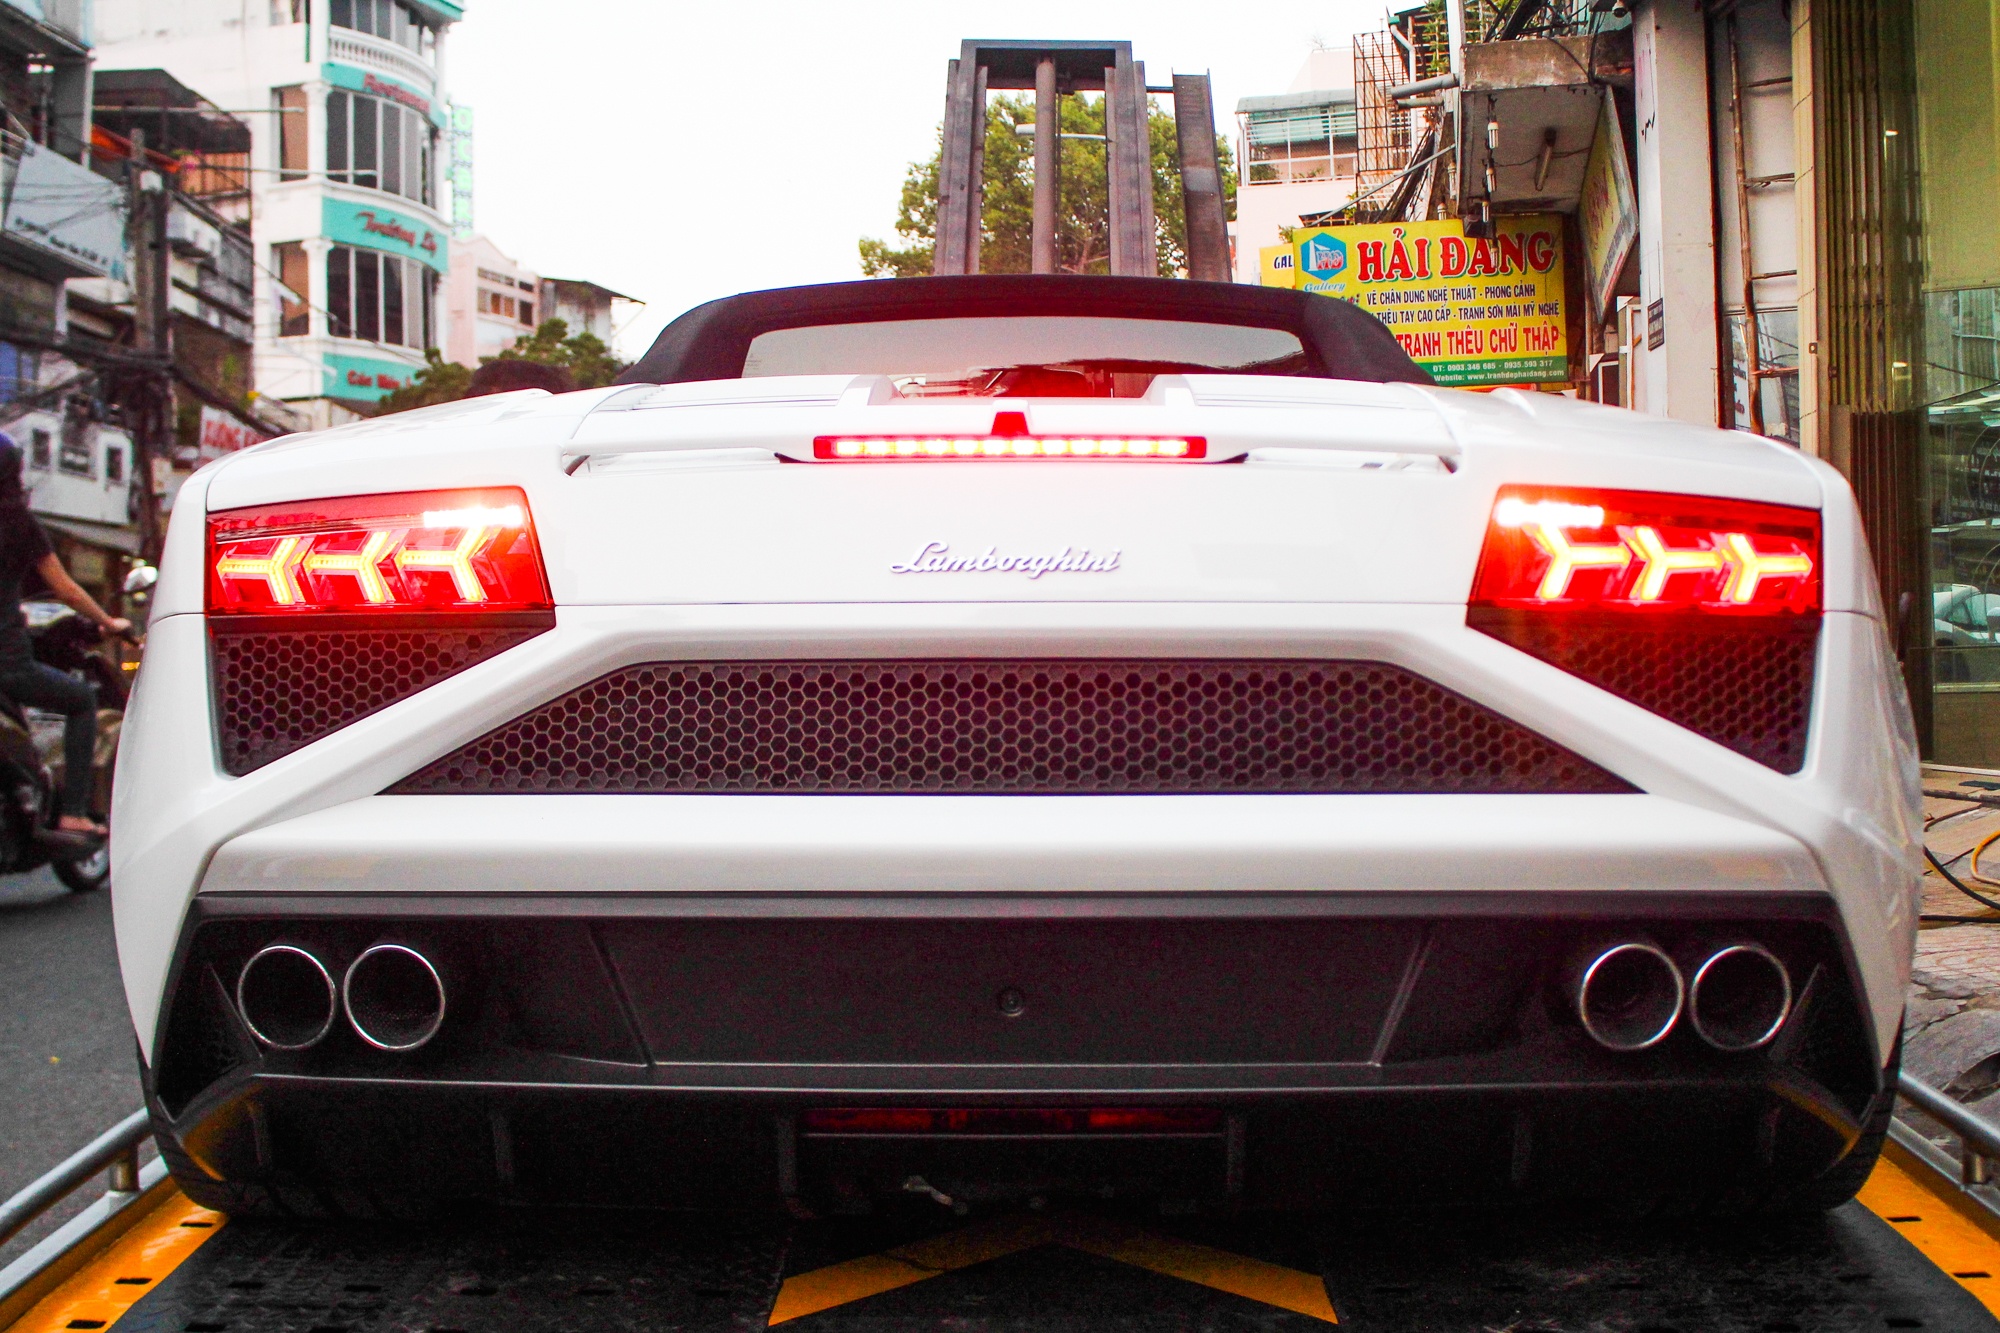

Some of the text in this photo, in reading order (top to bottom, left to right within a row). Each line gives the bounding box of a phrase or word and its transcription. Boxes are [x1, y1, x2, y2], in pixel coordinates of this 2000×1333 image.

[1273, 255, 1295, 269] GAL
[1357, 227, 1431, 281] HẢI
[1304, 282, 1346, 292] Gallery
[1380, 289, 1401, 305] CHÂN
[1403, 289, 1424, 304] DUNG
[1427, 285, 1448, 303] NGHỆ
[1451, 284, 1476, 303] THUẬT
[1484, 285, 1511, 299] PHONG
[1400, 310, 1415, 323] TAY
[1417, 309, 1433, 322] CAO
[1435, 303, 1451, 321] CẤP
[1458, 306, 1485, 320] TRANH
[1523, 300, 1535, 317] MỸ
[1538, 299, 1560, 318] NGHỆ
[1396, 320, 1559, 357] TRANH THÊU CHỮ THẬP
[889, 539, 1122, 579] Lamborghini
